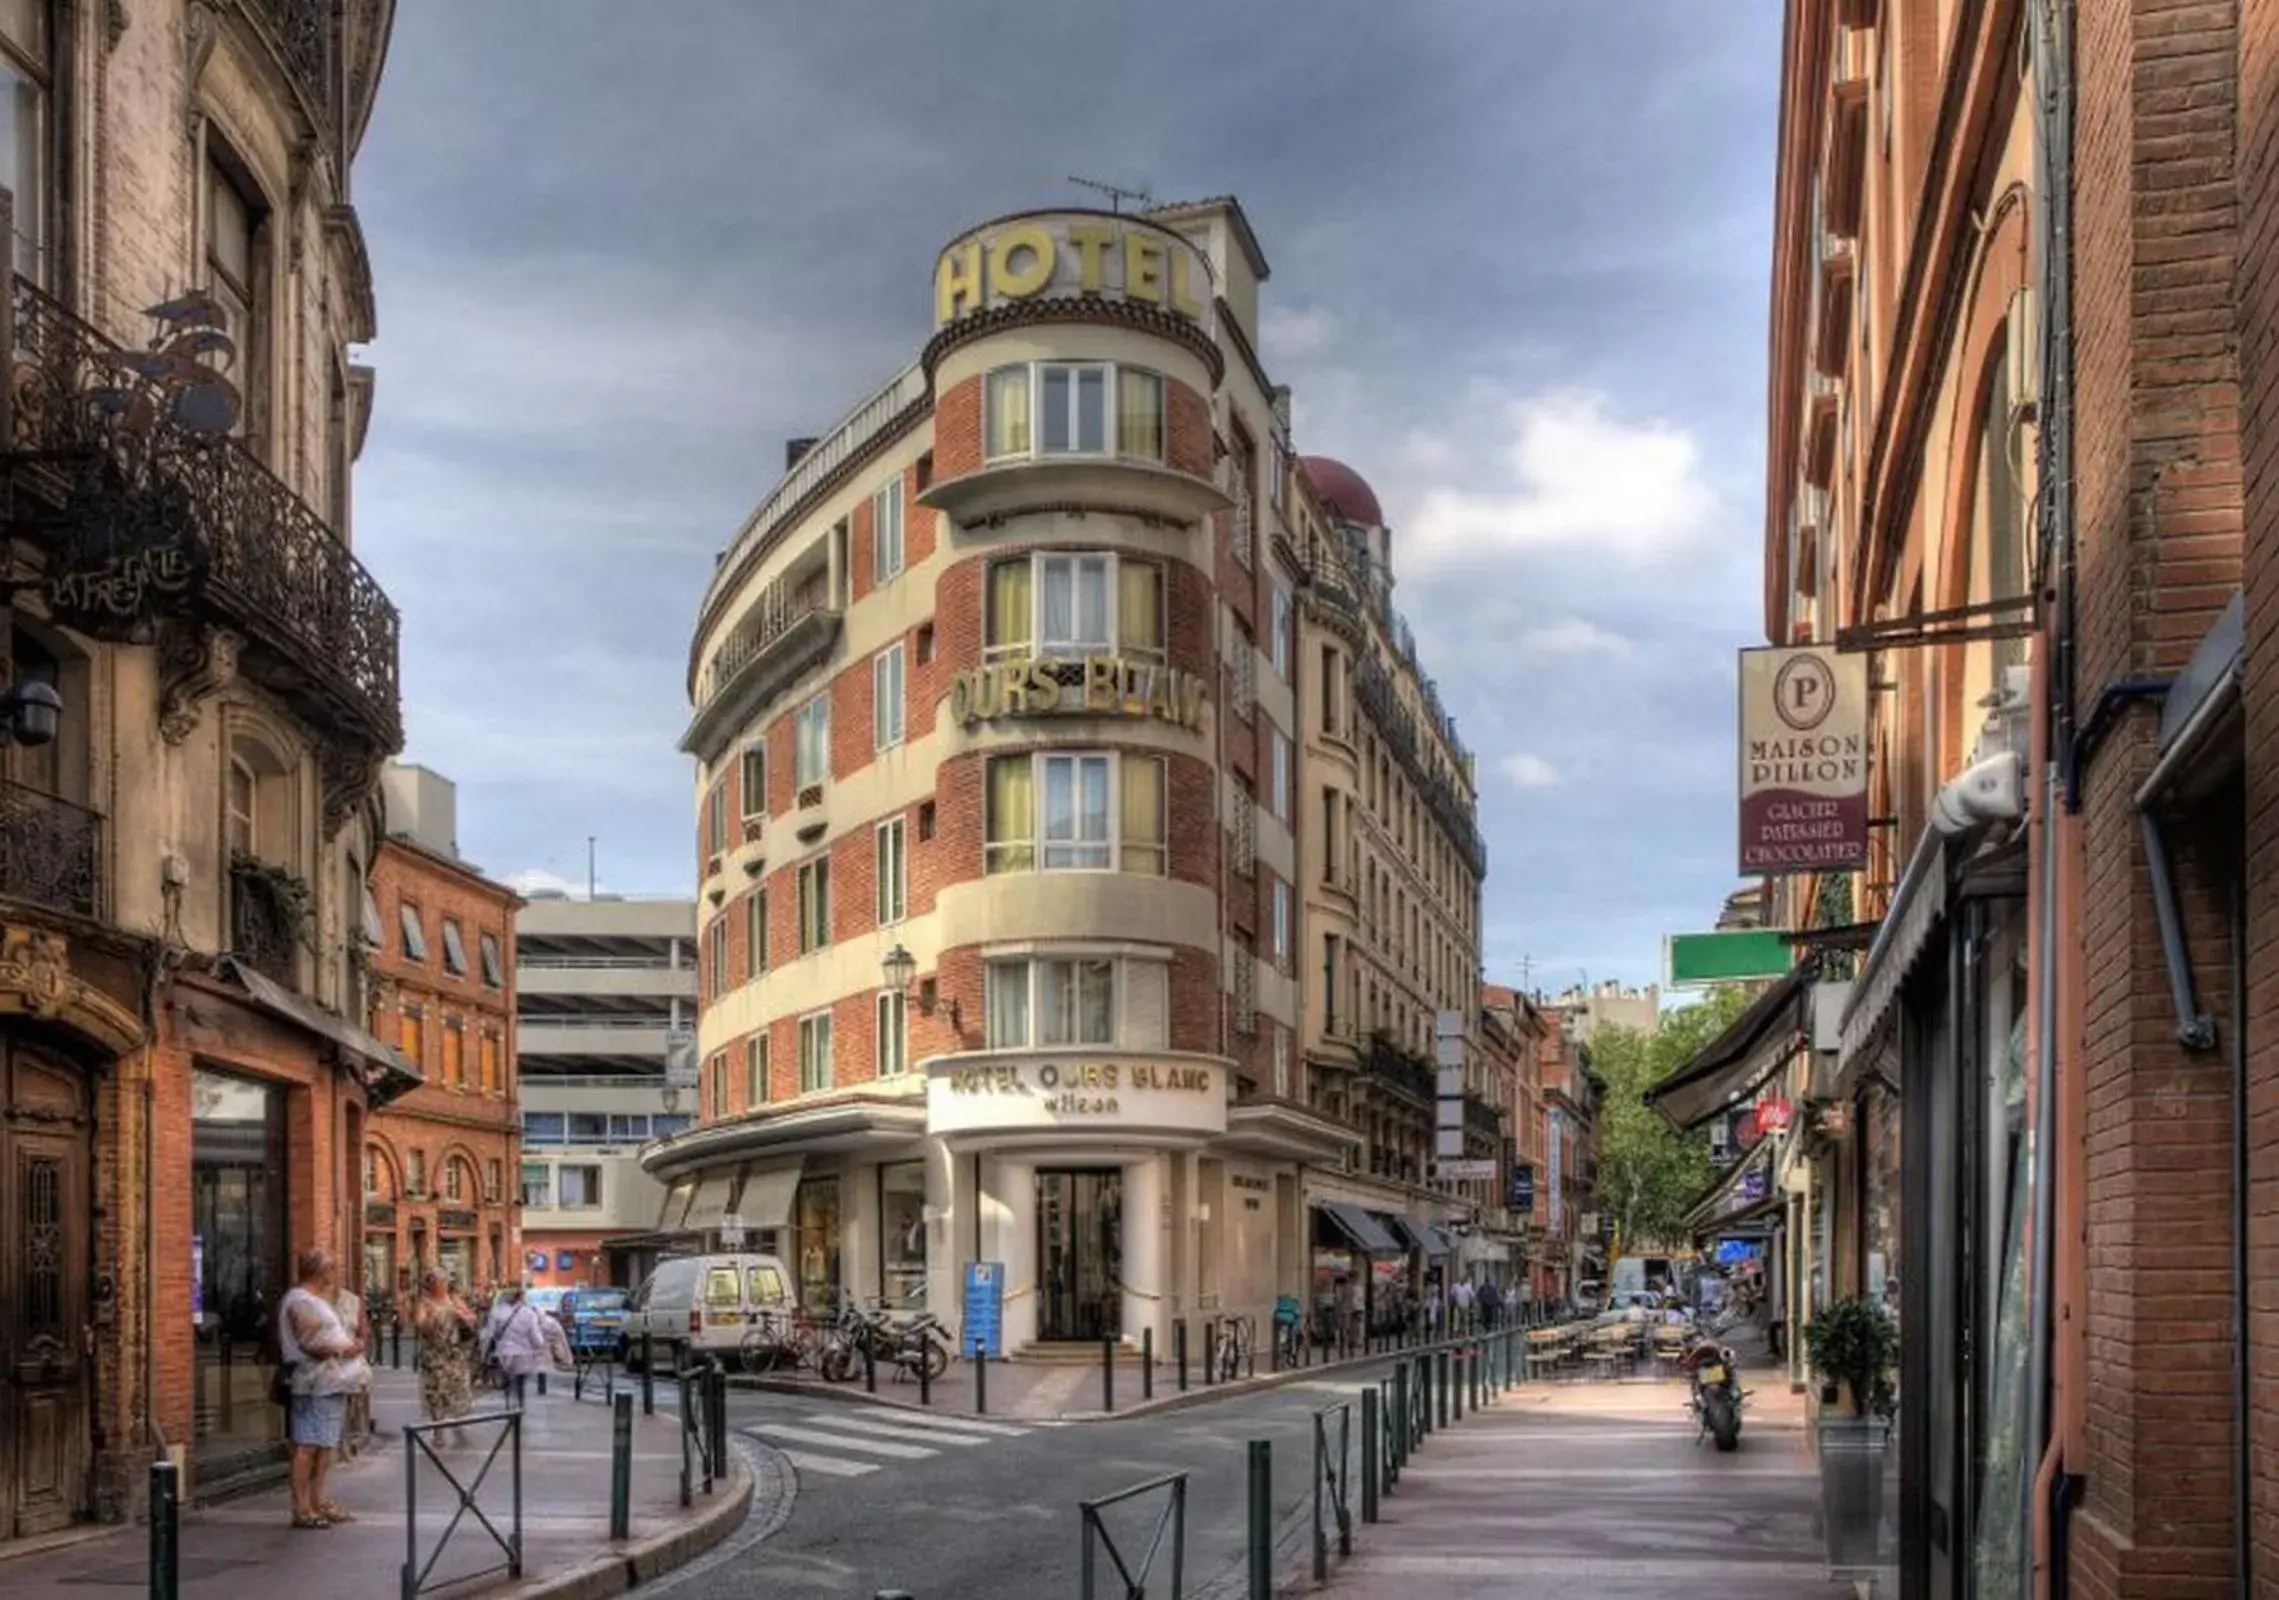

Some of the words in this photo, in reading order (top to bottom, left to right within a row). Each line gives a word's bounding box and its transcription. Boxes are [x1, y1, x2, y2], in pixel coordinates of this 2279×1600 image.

[939, 222, 1204, 324] HOTEL
[951, 658, 1062, 727] OURS
[1084, 655, 1208, 729] BLANC
[1793, 677, 1818, 708] P
[1749, 734, 1860, 761] MAISON
[1751, 760, 1858, 785] PILLON
[950, 1064, 1026, 1095] HOTEL
[1038, 1062, 1118, 1090] OURS
[1131, 1063, 1211, 1094] BLANC
